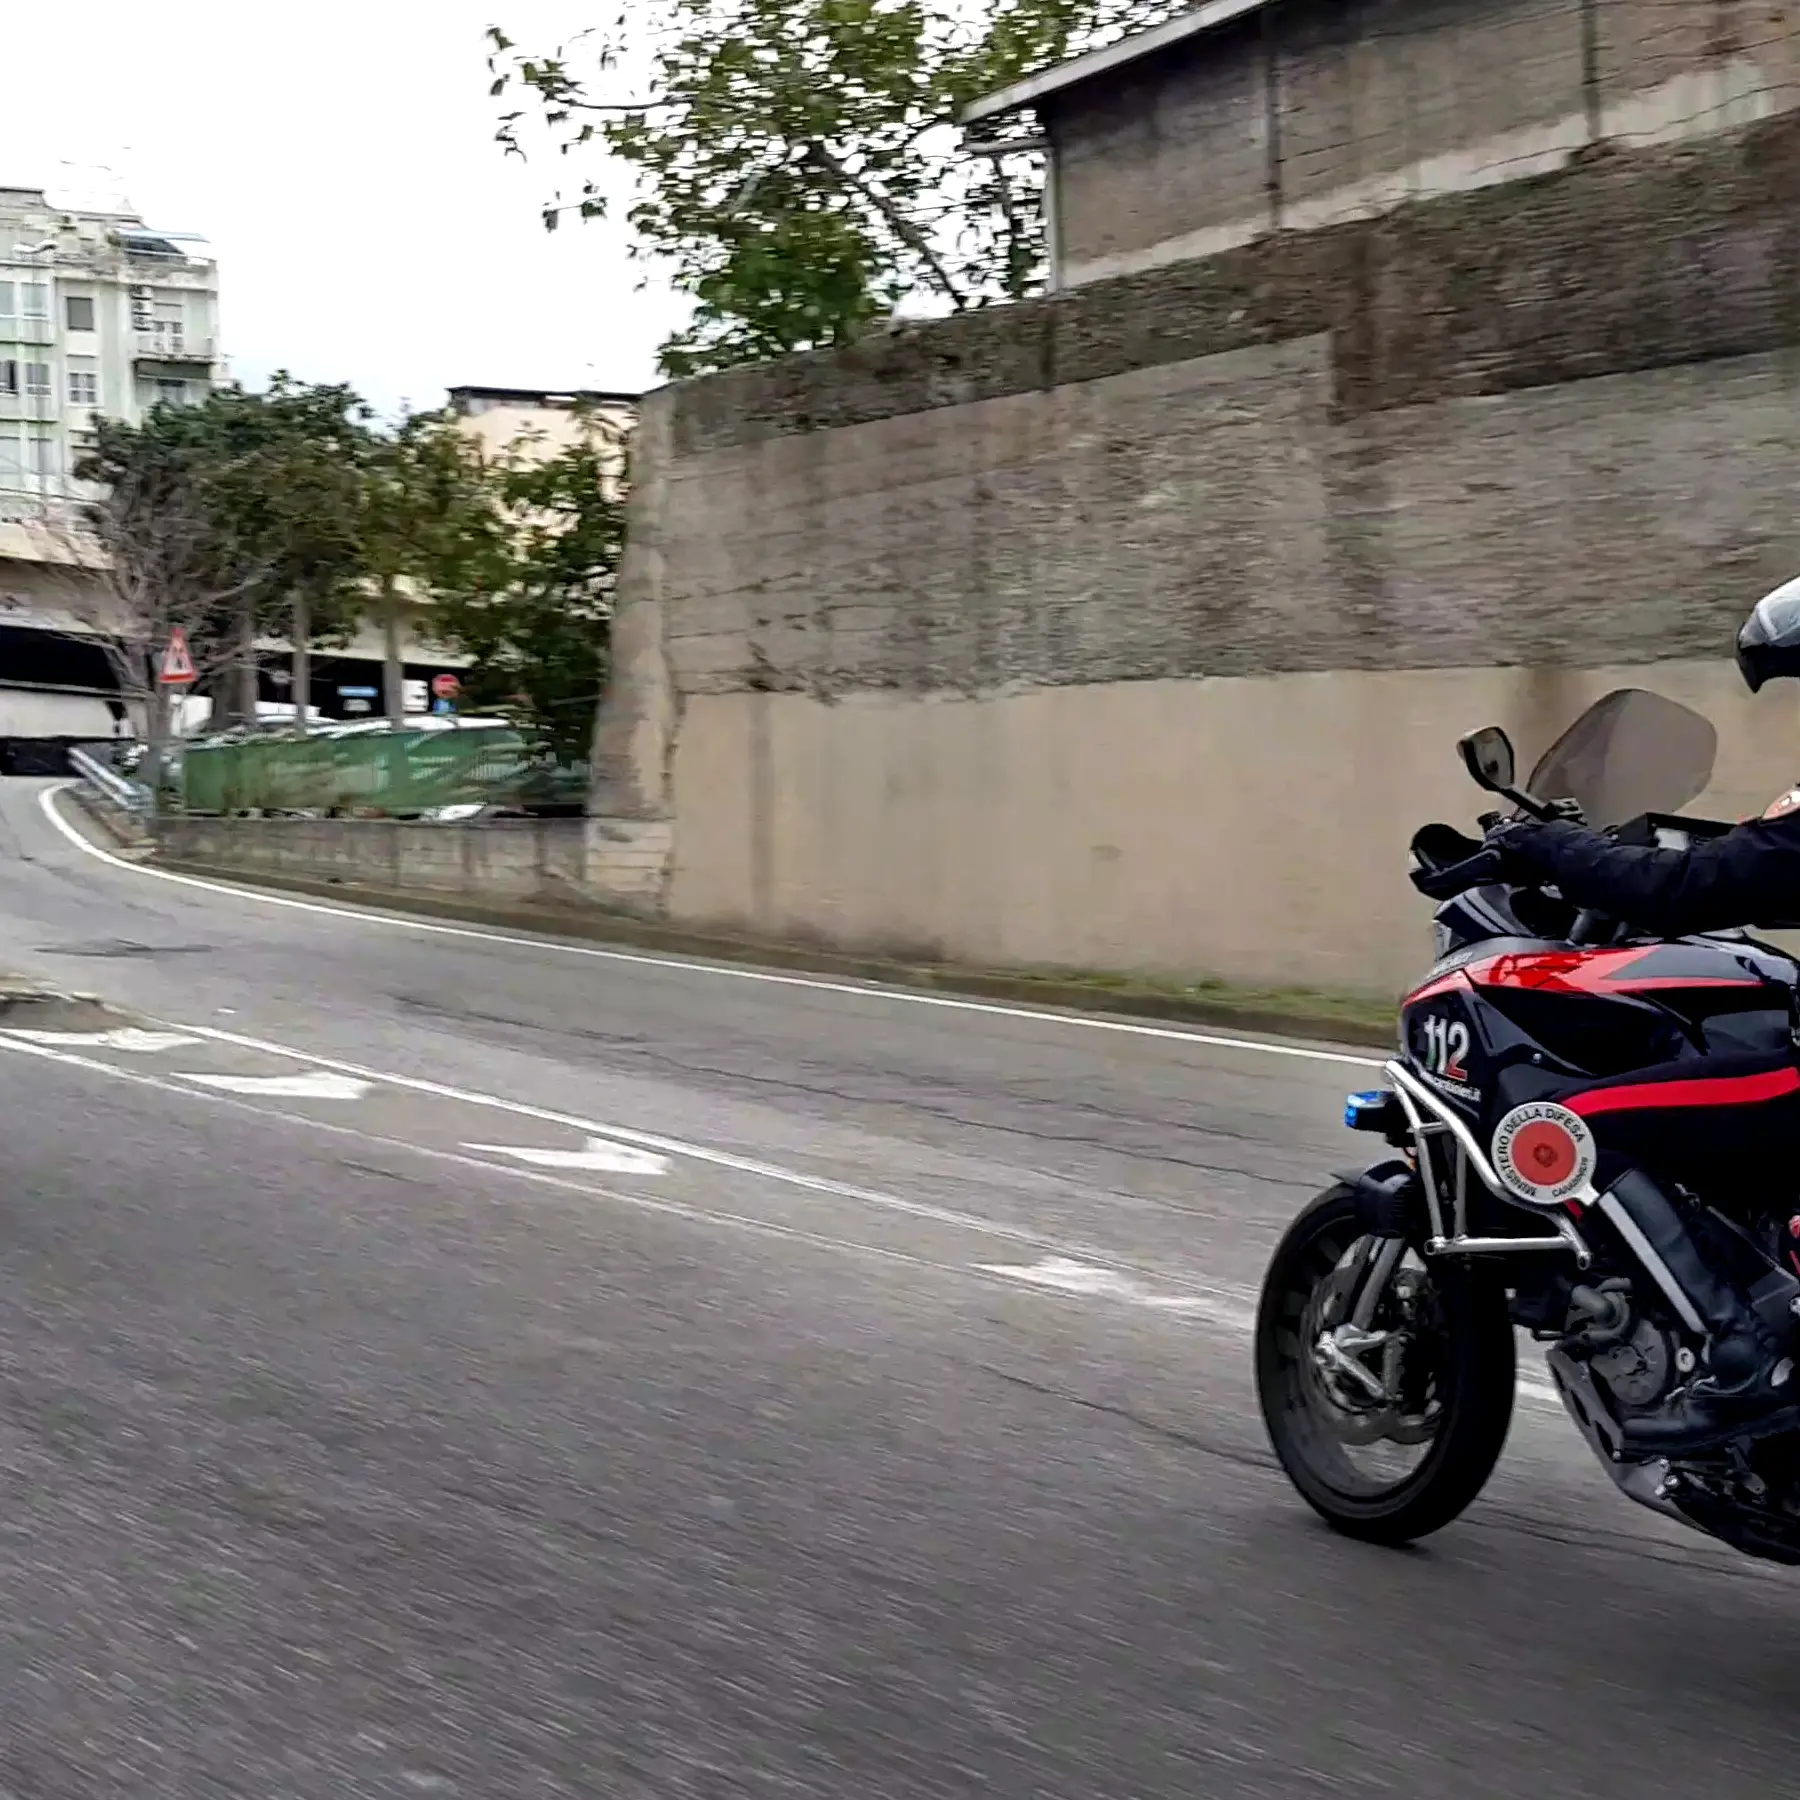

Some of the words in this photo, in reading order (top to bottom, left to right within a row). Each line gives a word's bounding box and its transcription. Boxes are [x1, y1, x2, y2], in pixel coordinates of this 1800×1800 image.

[1424, 1014, 1470, 1082] 112
[1504, 1108, 1542, 1134] DELLA
[1545, 1108, 1586, 1143] DIFESA
